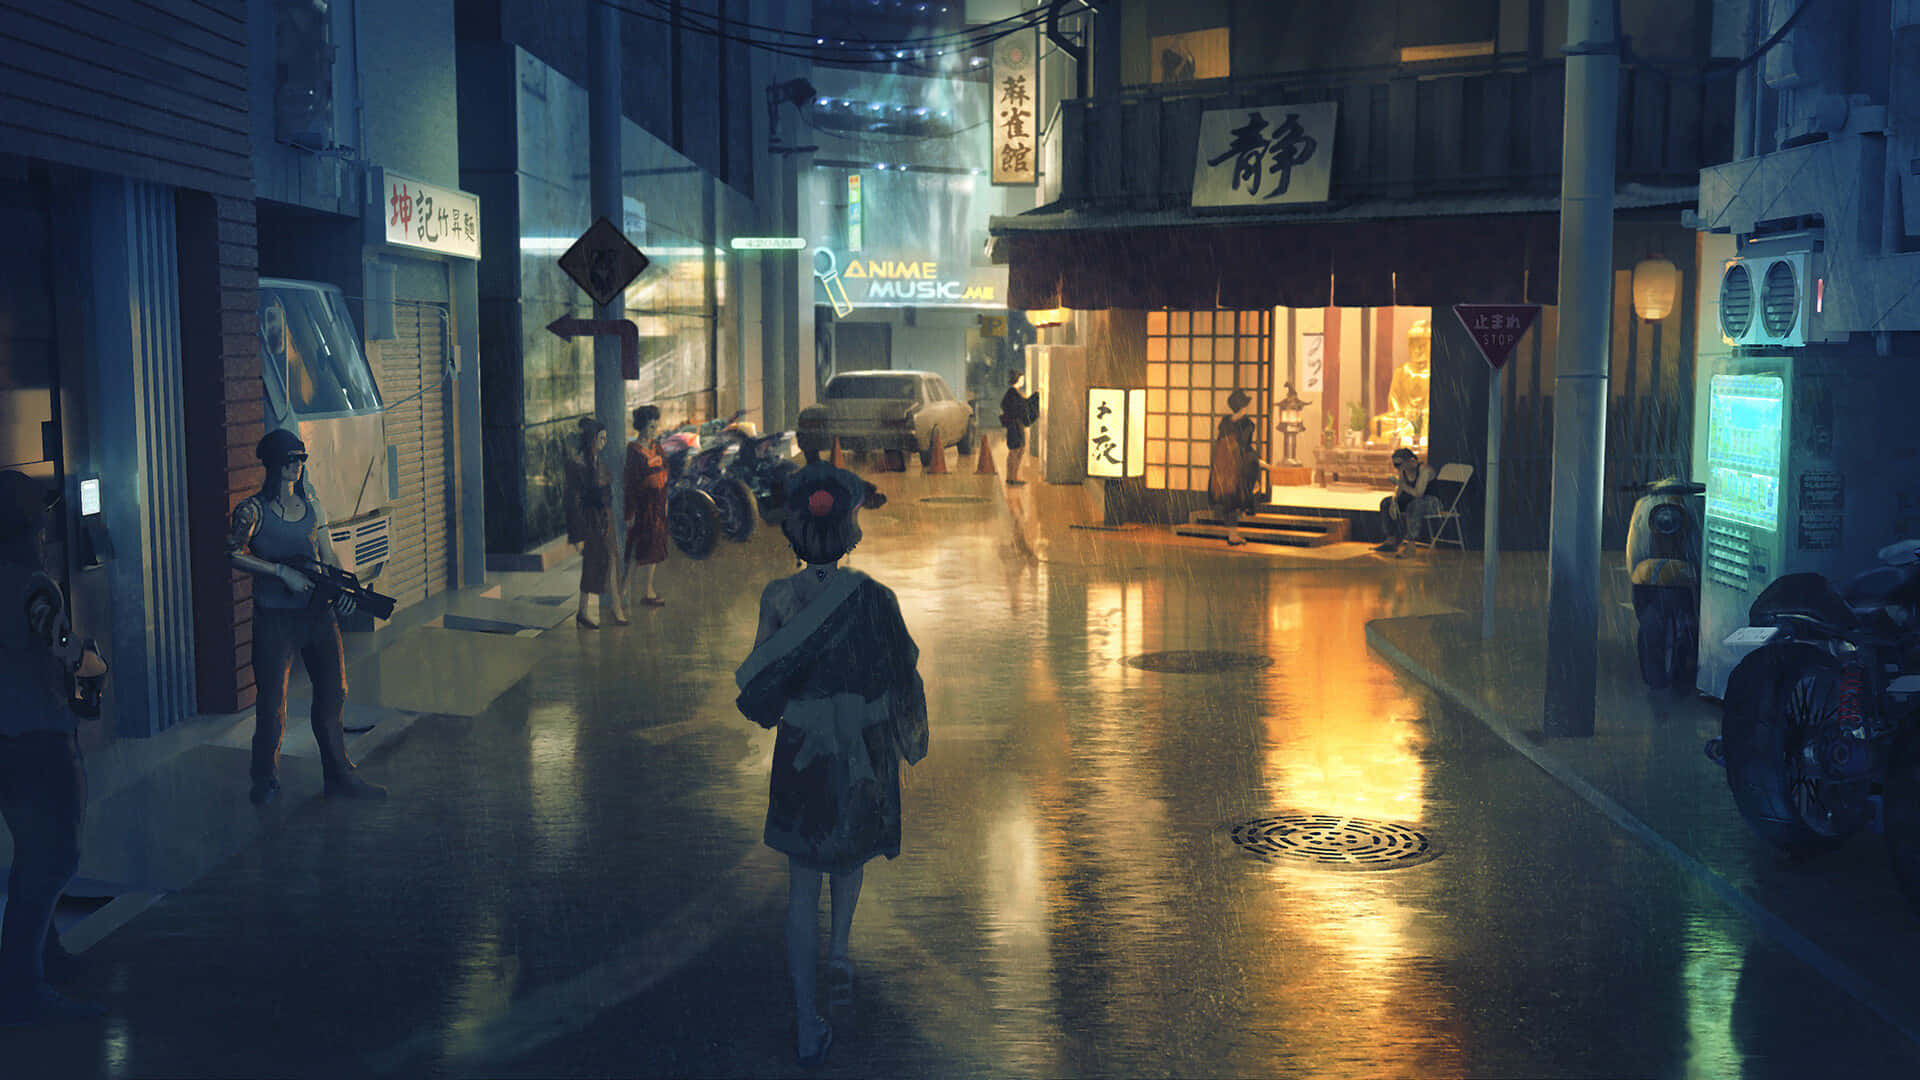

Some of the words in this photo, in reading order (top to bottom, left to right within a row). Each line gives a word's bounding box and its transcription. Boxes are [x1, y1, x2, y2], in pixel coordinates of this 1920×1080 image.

[843, 259, 937, 279] ANIME
[1473, 313, 1521, 330] 止まれ
[1482, 334, 1514, 345] STOP
